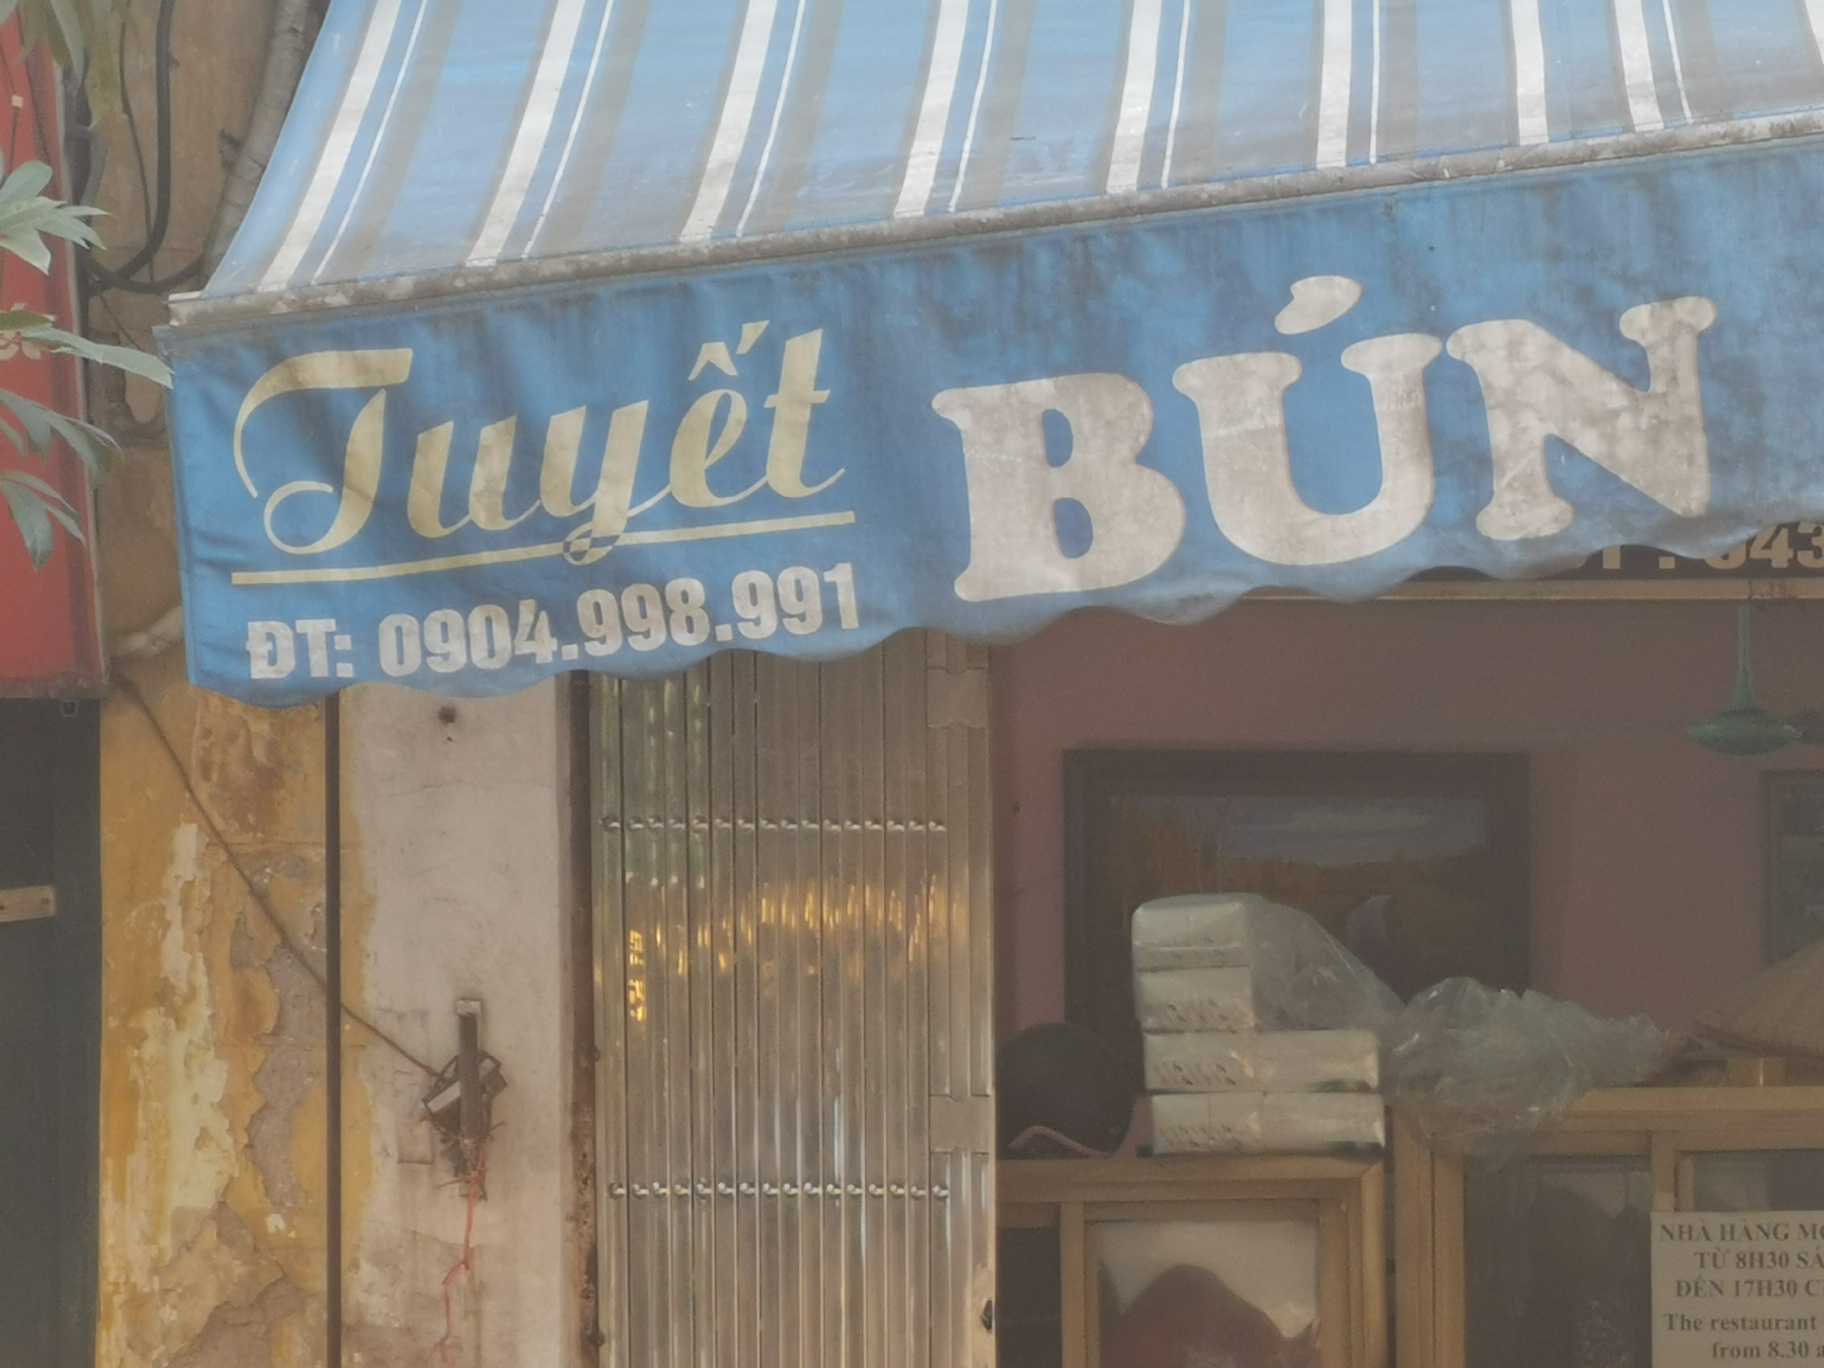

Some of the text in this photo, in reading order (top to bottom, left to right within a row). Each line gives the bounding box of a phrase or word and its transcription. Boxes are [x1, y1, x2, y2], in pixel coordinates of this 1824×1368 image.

[233, 320, 845, 566] Tuyết
[932, 275, 1717, 601] BÚN
[246, 562, 859, 680] ĐT: 0904.998.991
[1661, 1221, 1712, 1242] NHÀ
[1719, 1221, 1789, 1242] HÀNG
[1736, 1250, 1790, 1269] 8H30
[1734, 1279, 1798, 1298] 17H30
[1664, 1313, 1703, 1331] The
[1711, 1315, 1817, 1331] restaurant
[1712, 1342, 1761, 1358] from
[1768, 1341, 1810, 1358] 8.30
